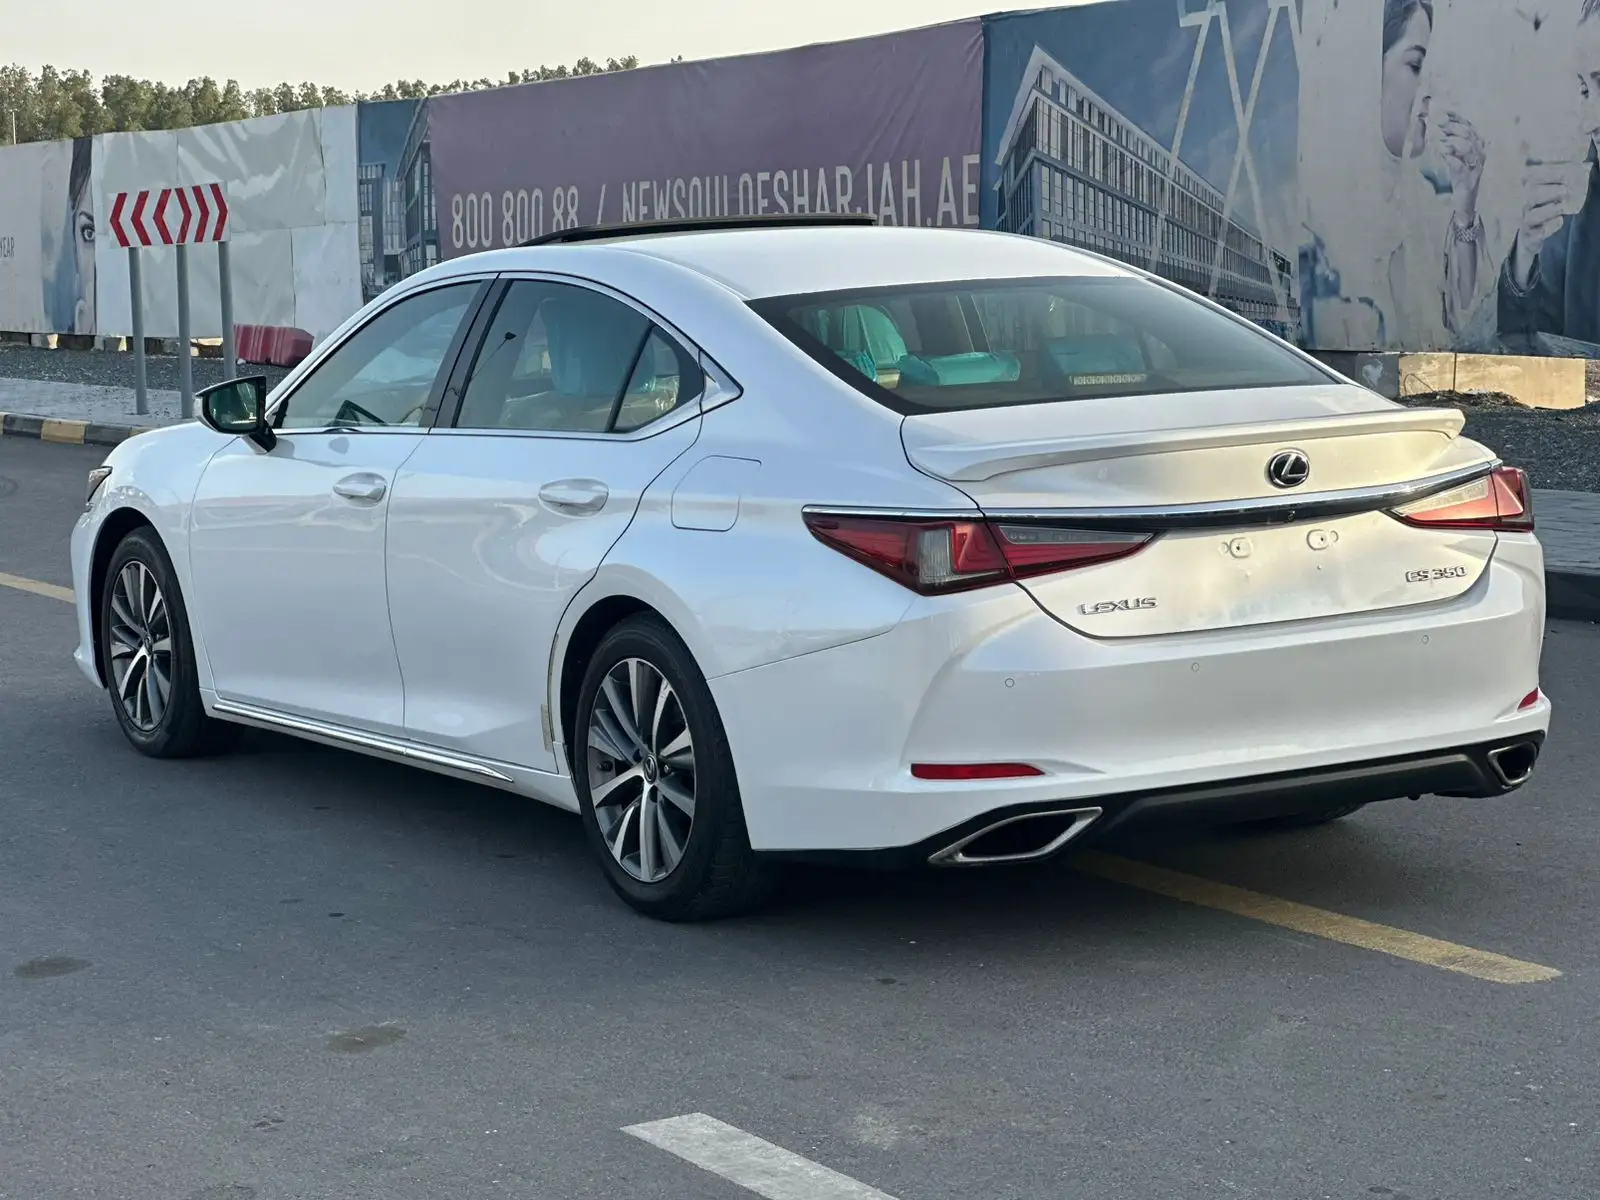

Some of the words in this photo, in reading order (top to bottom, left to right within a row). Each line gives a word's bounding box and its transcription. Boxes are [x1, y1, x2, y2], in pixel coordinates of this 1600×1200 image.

[452, 193, 493, 248] 800
[502, 189, 543, 246] 800
[552, 185, 579, 232] 88
[1405, 570, 1430, 583] ES
[1431, 566, 1467, 580] 350
[1076, 597, 1158, 615] LEXUS
